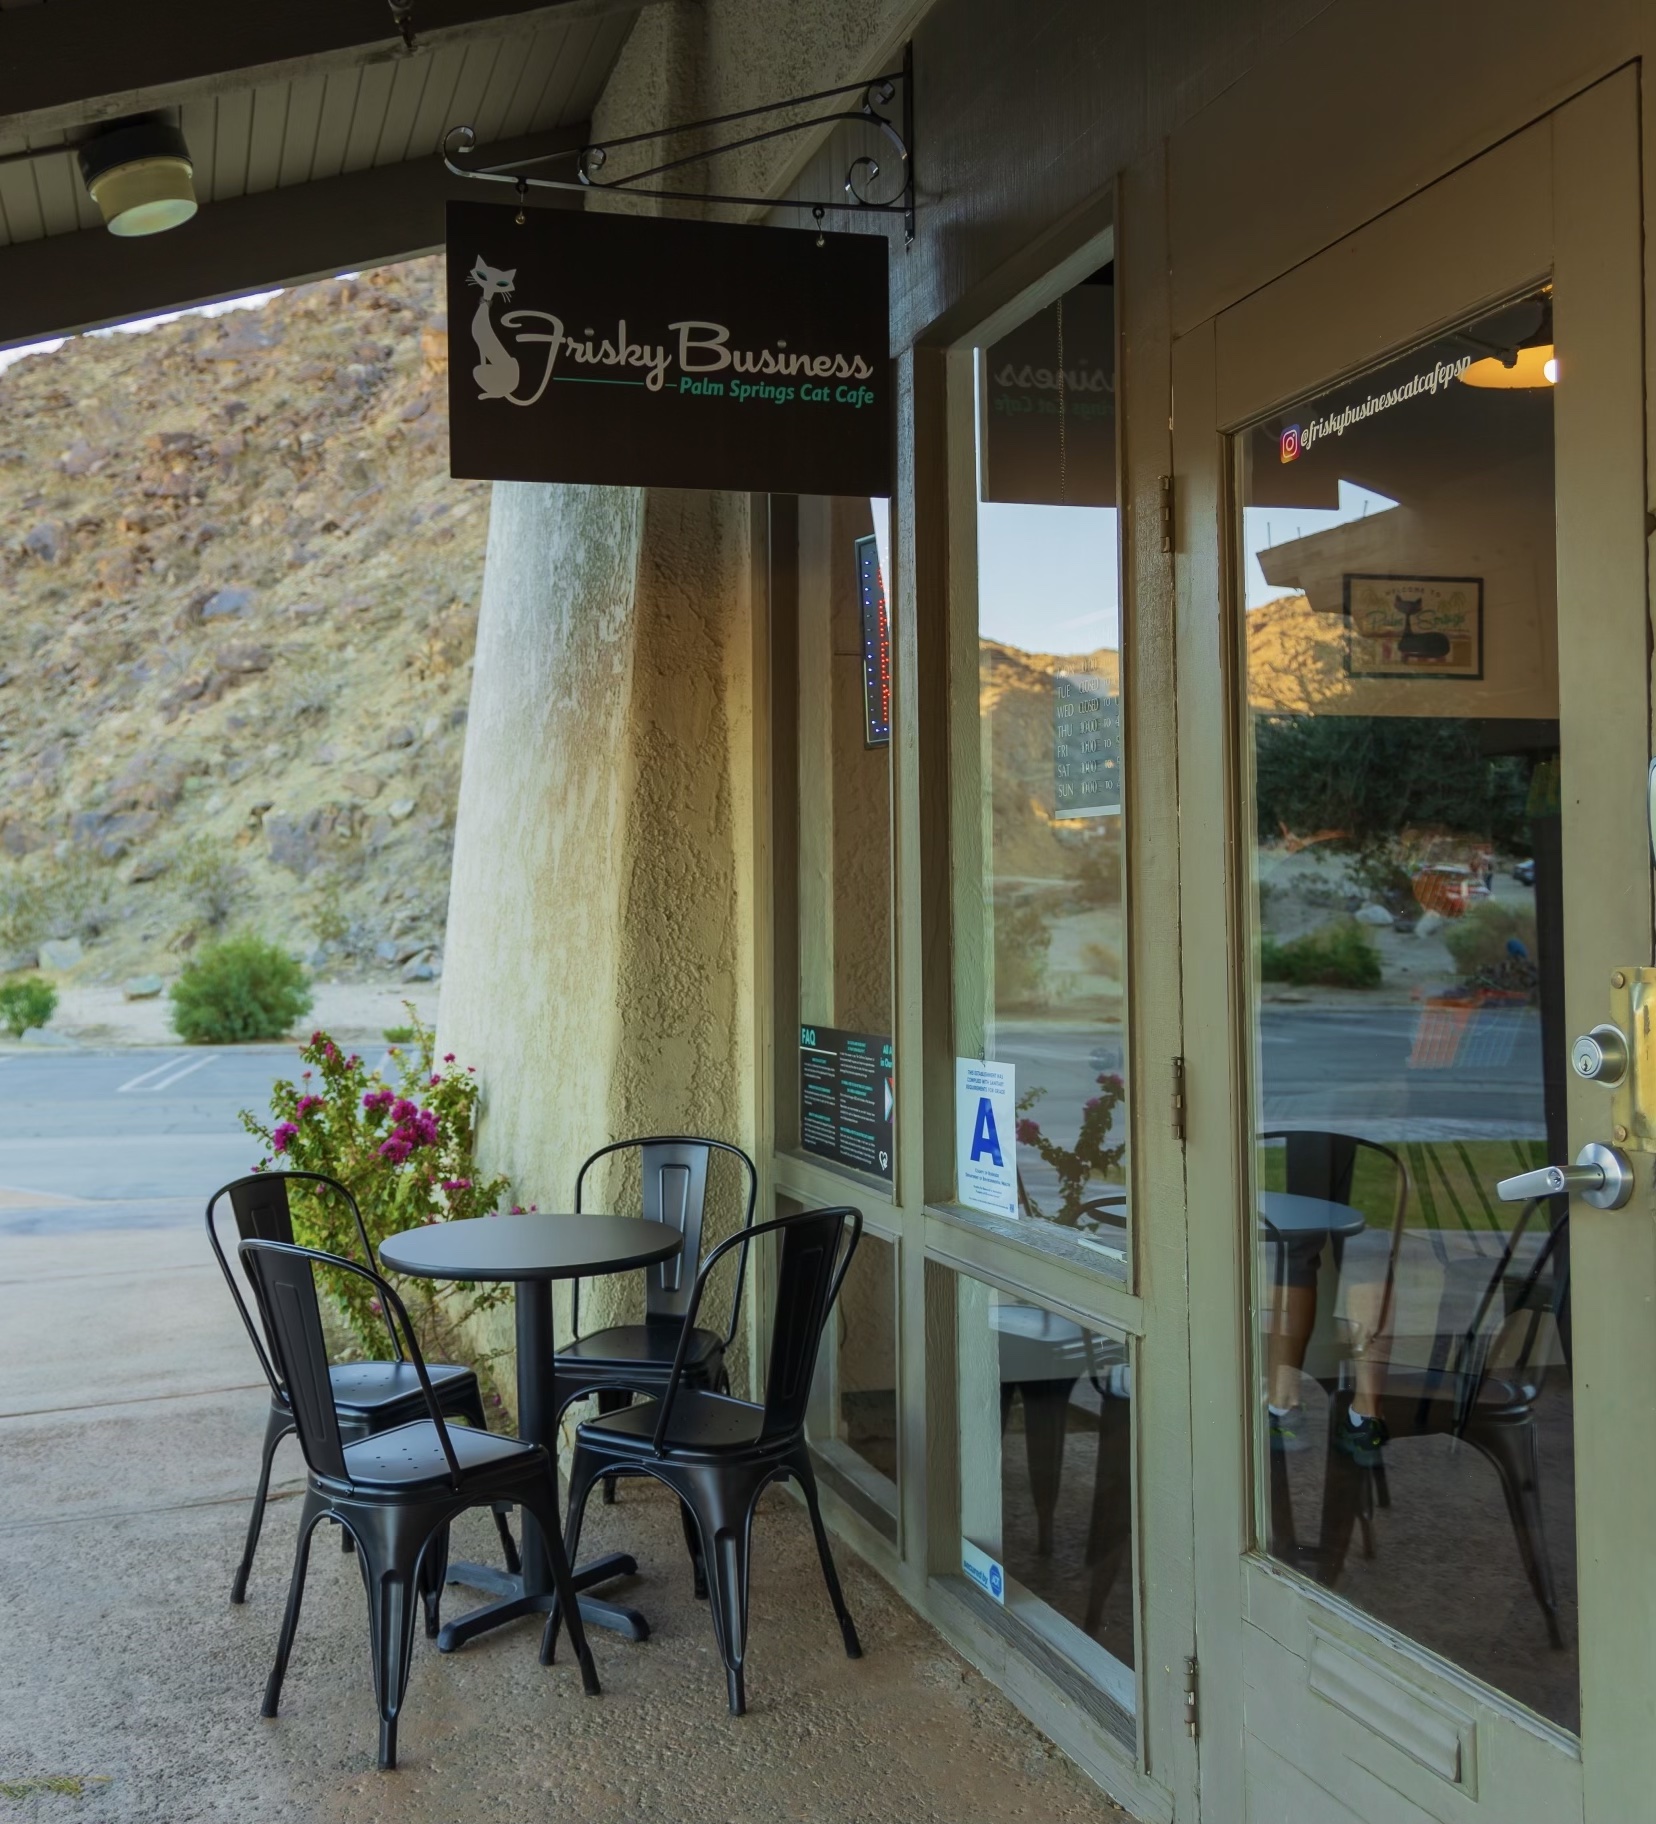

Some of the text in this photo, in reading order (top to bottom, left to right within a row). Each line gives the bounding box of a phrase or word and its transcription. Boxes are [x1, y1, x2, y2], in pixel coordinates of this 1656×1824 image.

[500, 310, 874, 407] Frisky Business
[680, 377, 874, 408] Palm Springs Cat Cafe
[1300, 355, 1471, 450] @friskybusinesscatcafepsp
[1057, 685, 1071, 700] TUE
[1057, 704, 1074, 718] WED
[1057, 724, 1073, 739] THU
[1057, 744, 1069, 759] FRI
[1057, 763, 1071, 778] SAT
[1058, 783, 1074, 798] SUN
[801, 1028, 816, 1046] FAQ
[970, 1097, 1004, 1167] A
